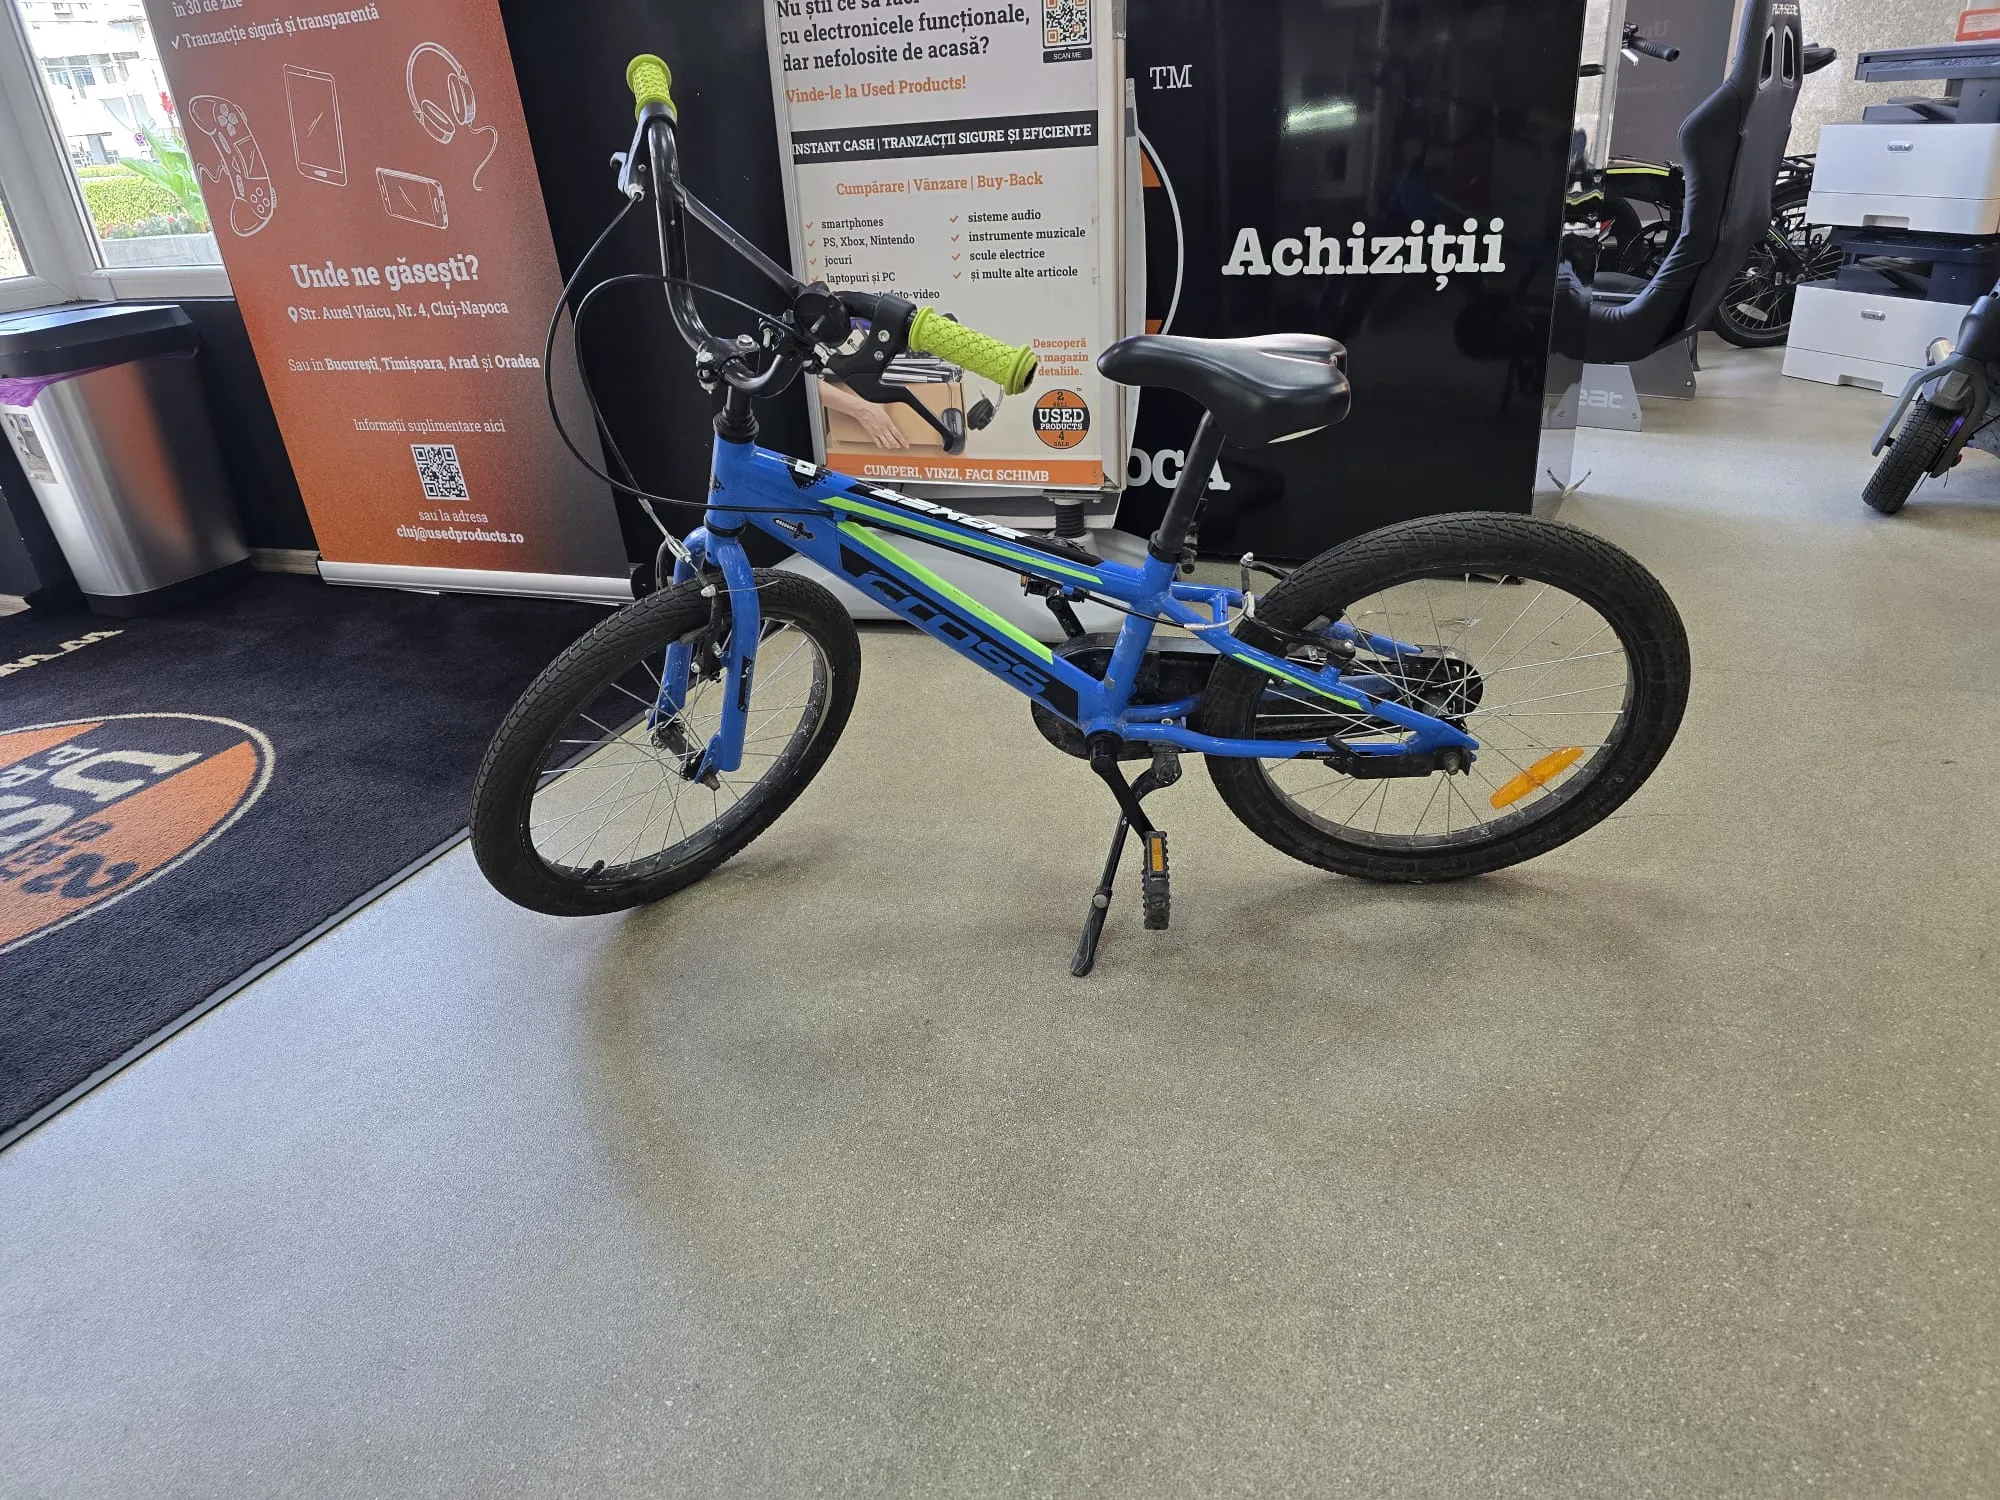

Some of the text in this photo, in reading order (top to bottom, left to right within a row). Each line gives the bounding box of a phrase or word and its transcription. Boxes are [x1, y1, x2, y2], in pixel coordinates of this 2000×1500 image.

[186, 0, 202, 15] 30
[203, 0, 220, 12] de
[778, 0, 801, 17] Nu
[837, 0, 856, 11] ce
[182, 2, 380, 48] Tranzacție sigură și transparentă
[780, 5, 1030, 45] cu electronicele funcționale,
[783, 36, 990, 72] dar nefolosite de acasă?
[1053, 52, 1069, 60] SCAN
[1149, 64, 1193, 89] TM
[786, 75, 967, 104] Vinde-le la Used Products!
[843, 139, 875, 152] CASH
[883, 133, 957, 150] TRANZACȚII
[958, 130, 1005, 145] SIGURE
[1007, 128, 1020, 145] ȘI
[1022, 124, 1092, 140] EFICIENTE
[836, 171, 1043, 197] Cumpărare Vânzare Buy-Back
[821, 217, 884, 231] smartphones
[968, 209, 1041, 223] sisteme audio
[823, 234, 915, 249] PS, Xbox, Nintendo
[968, 227, 1086, 242] instrumente muzicale
[824, 254, 853, 268] jocuri
[969, 249, 1045, 262] scule electrice
[1221, 217, 1505, 291] Achiziții
[290, 254, 479, 291] Unde ne găsești?
[826, 272, 896, 286] laptopuri și PC
[970, 267, 1078, 281] și multe alte articole
[299, 301, 509, 321] Str. Aurel Vlaicu, Nr. 4, Cluj-Napoca
[1033, 337, 1087, 350] Descoperă
[289, 358, 309, 372] Sau
[327, 356, 382, 374] București,
[381, 356, 447, 374] Timișoara,
[449, 355, 479, 369] Arad
[482, 356, 493, 372] și
[495, 355, 540, 369] Oradea
[1044, 351, 1089, 364] magazin
[1038, 366, 1082, 376] detaliile.
[1038, 408, 1084, 423] USED
[353, 418, 506, 435] Informații suplimentare aici
[864, 463, 1050, 484] CUMPERI, VINZI, FACI SCHIMB
[418, 510, 489, 524] sau la adresa
[397, 525, 524, 544] cluj@usedproducts.ro
